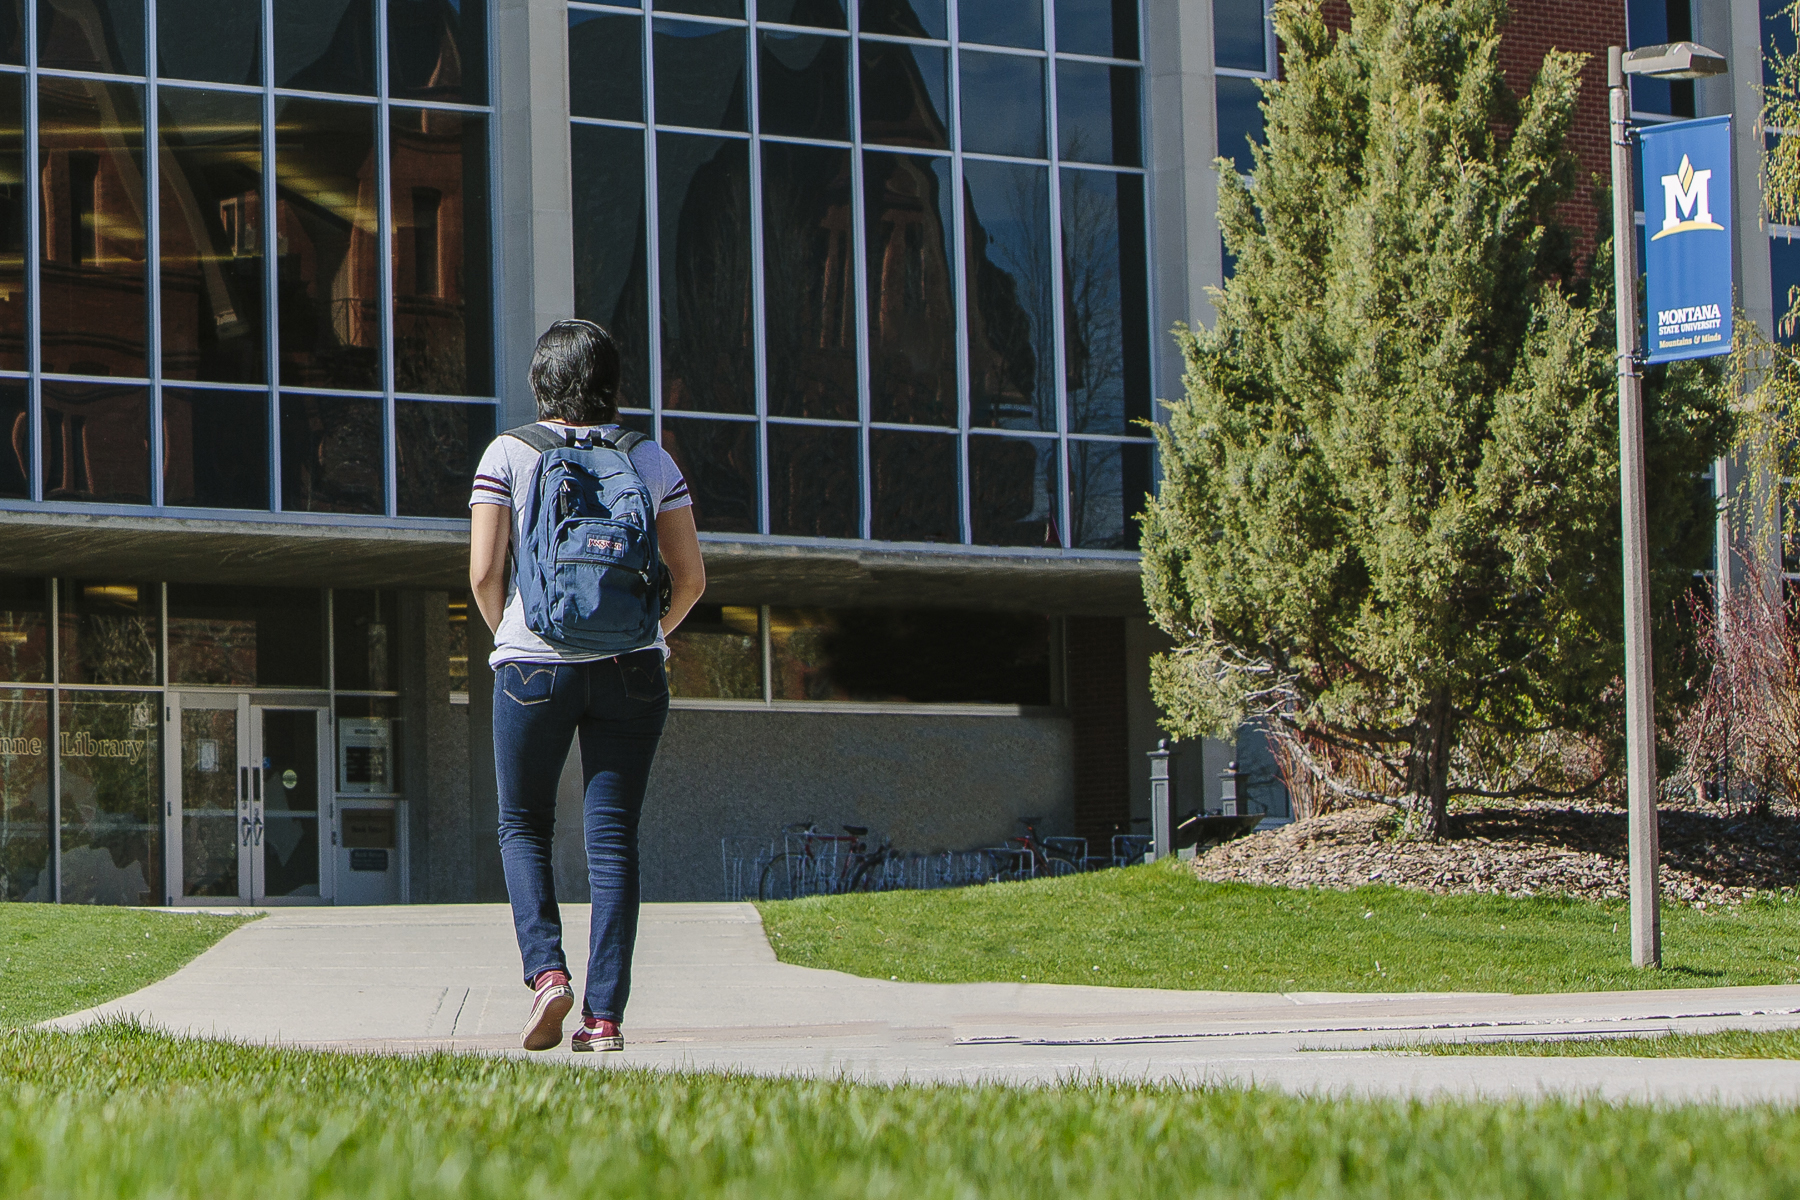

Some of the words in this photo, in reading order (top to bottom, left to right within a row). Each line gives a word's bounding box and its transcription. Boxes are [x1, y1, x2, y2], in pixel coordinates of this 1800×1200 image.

[1658, 304, 1721, 326] MONTANA
[1658, 325, 1680, 336] STATE
[1680, 319, 1721, 333] UNIVERSITY
[1659, 337, 1693, 349] Mountains
[1693, 335, 1701, 345] &
[1701, 332, 1721, 344] Minds
[60, 731, 145, 765] Library
